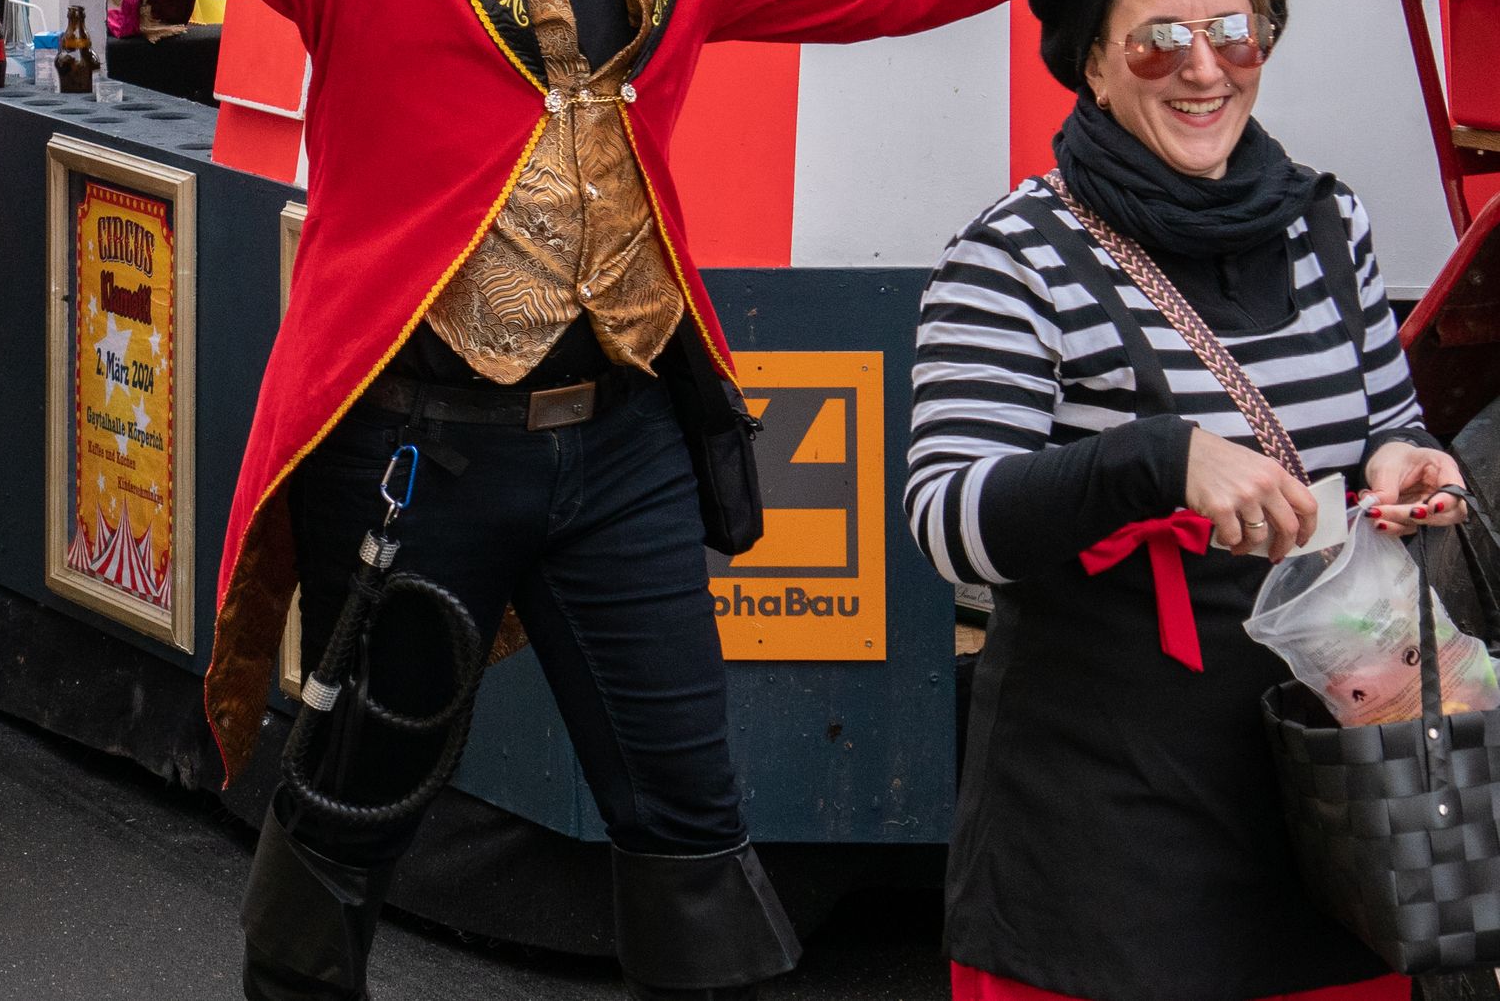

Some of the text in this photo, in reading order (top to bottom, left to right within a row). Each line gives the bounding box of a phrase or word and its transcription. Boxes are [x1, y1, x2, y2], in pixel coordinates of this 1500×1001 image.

[97, 216, 155, 278] CIRCUS
[96, 347, 154, 395] 2. März 2024
[86, 406, 163, 451] Gaytalhalle Körperich
